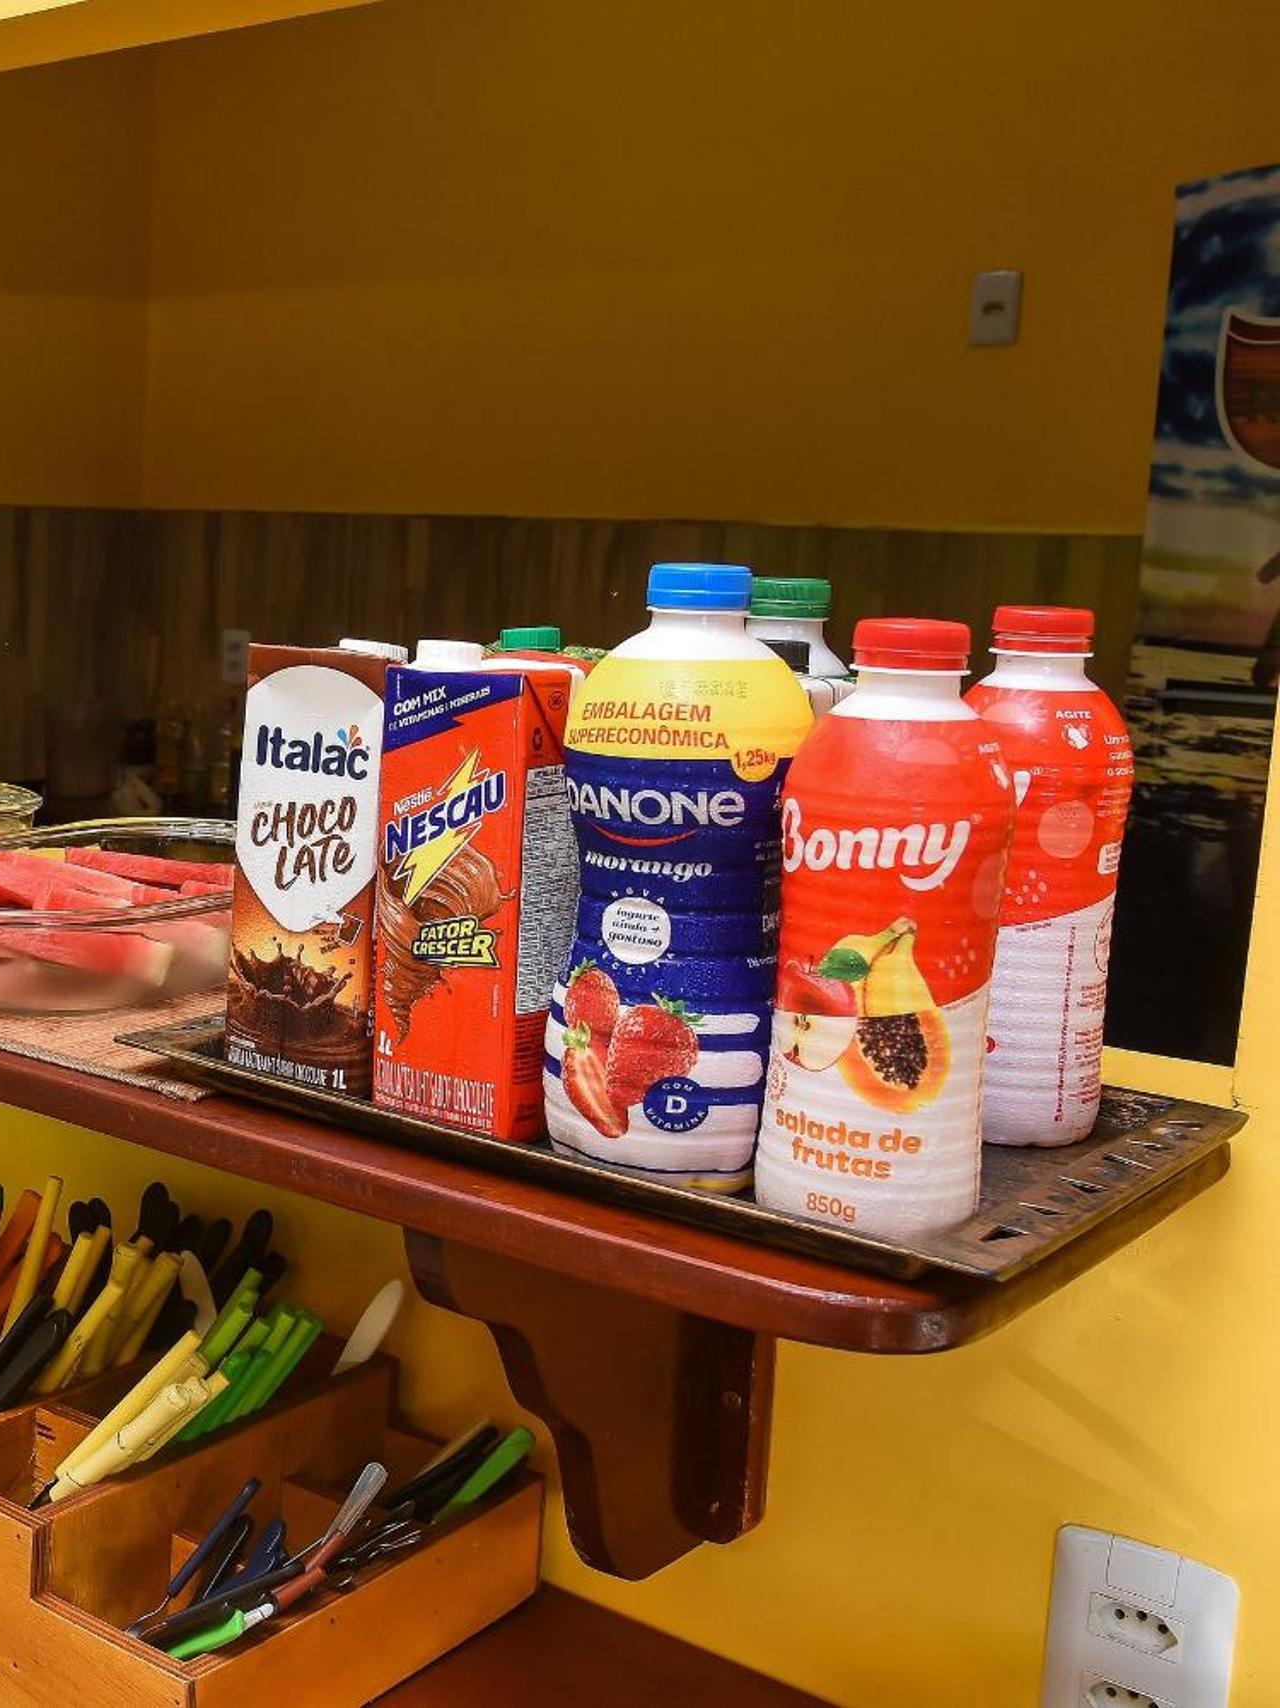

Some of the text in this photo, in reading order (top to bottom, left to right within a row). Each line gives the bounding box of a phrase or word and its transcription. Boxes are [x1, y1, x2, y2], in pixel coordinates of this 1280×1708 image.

[393, 685, 447, 716] COM MIX
[582, 701, 712, 723] EMBALAGEM
[1055, 710, 1094, 720] AGITE
[568, 725, 730, 750] SUPERECONÔMICA
[256, 724, 370, 781] Italac
[250, 796, 358, 849] CHOCO
[385, 770, 507, 863] NESCAU
[782, 798, 971, 892] Bonny
[584, 850, 714, 884] morango
[612, 919, 648, 932] ainda
[616, 906, 660, 921] iogurte
[420, 917, 475, 942] FATOR
[607, 931, 663, 948] gostoso
[412, 931, 495, 964] CRESCER
[331, 1068, 348, 1090] 1L
[662, 1082, 694, 1092] COM
[665, 1095, 687, 1114] D
[645, 1106, 705, 1130] VITAMINA
[775, 1108, 922, 1154] salada de
[791, 1136, 893, 1180] frutas
[806, 1192, 857, 1224] 850g
